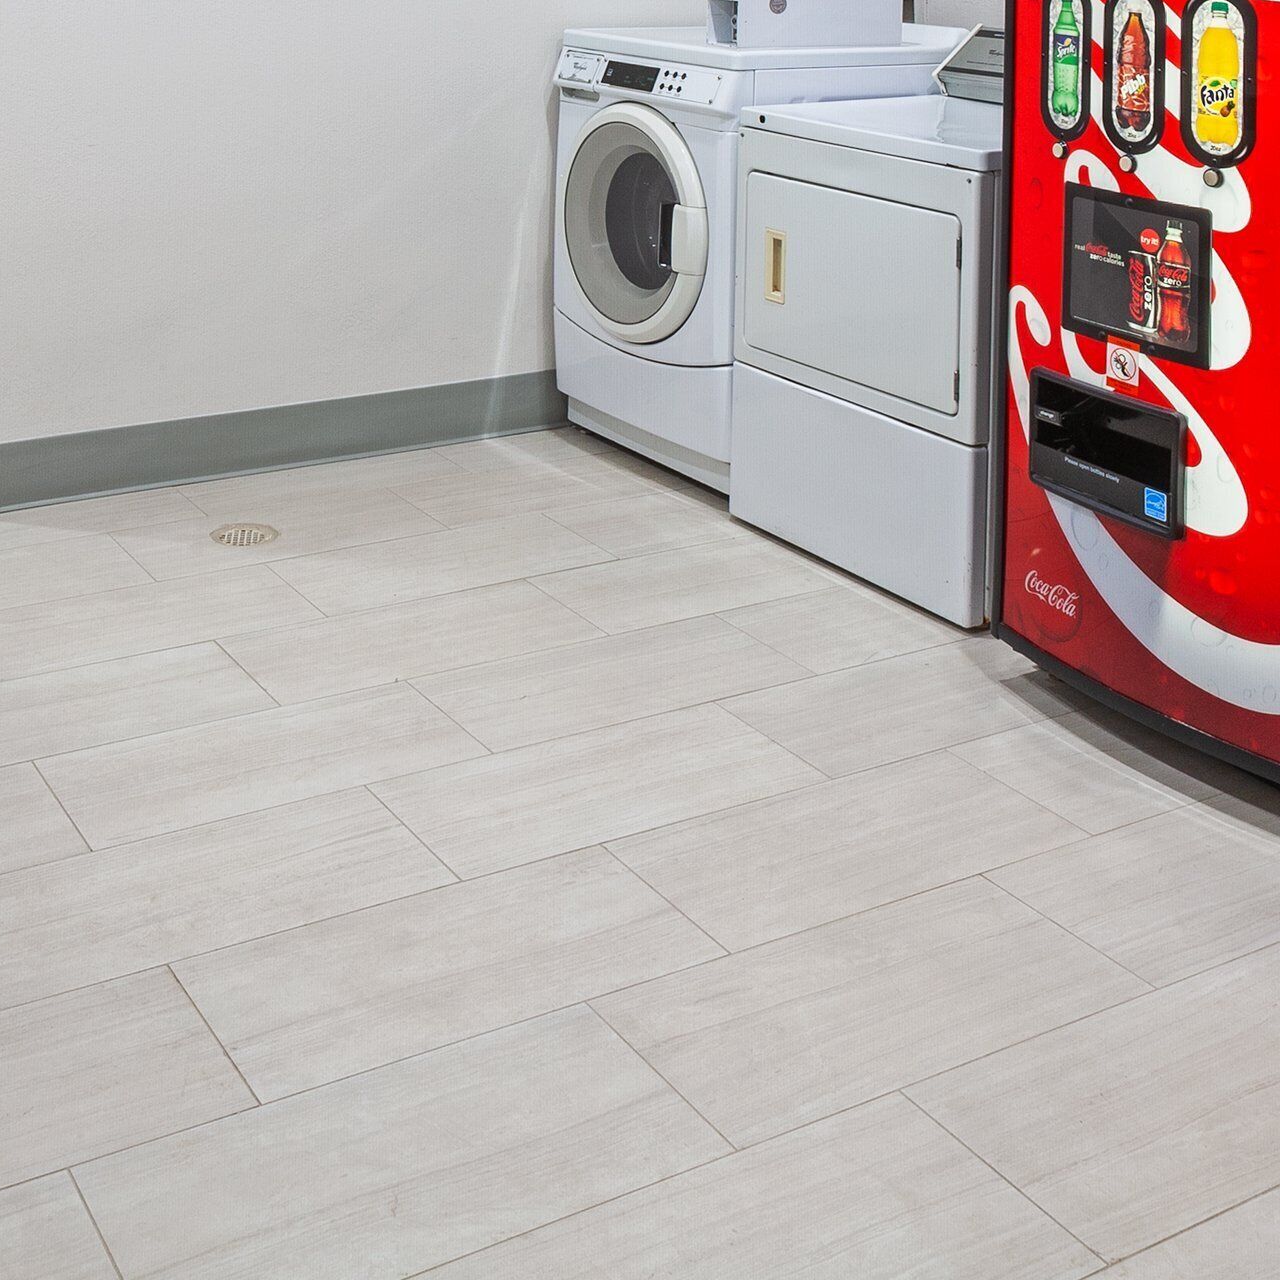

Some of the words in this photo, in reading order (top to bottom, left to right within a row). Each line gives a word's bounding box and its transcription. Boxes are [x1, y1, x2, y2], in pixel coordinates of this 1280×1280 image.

[1140, 235, 1151, 245] try
[1074, 243, 1086, 251] real
[1163, 276, 1182, 287] zero
[1144, 275, 1153, 311] zero
[1024, 569, 1080, 617] Coca-Cola
